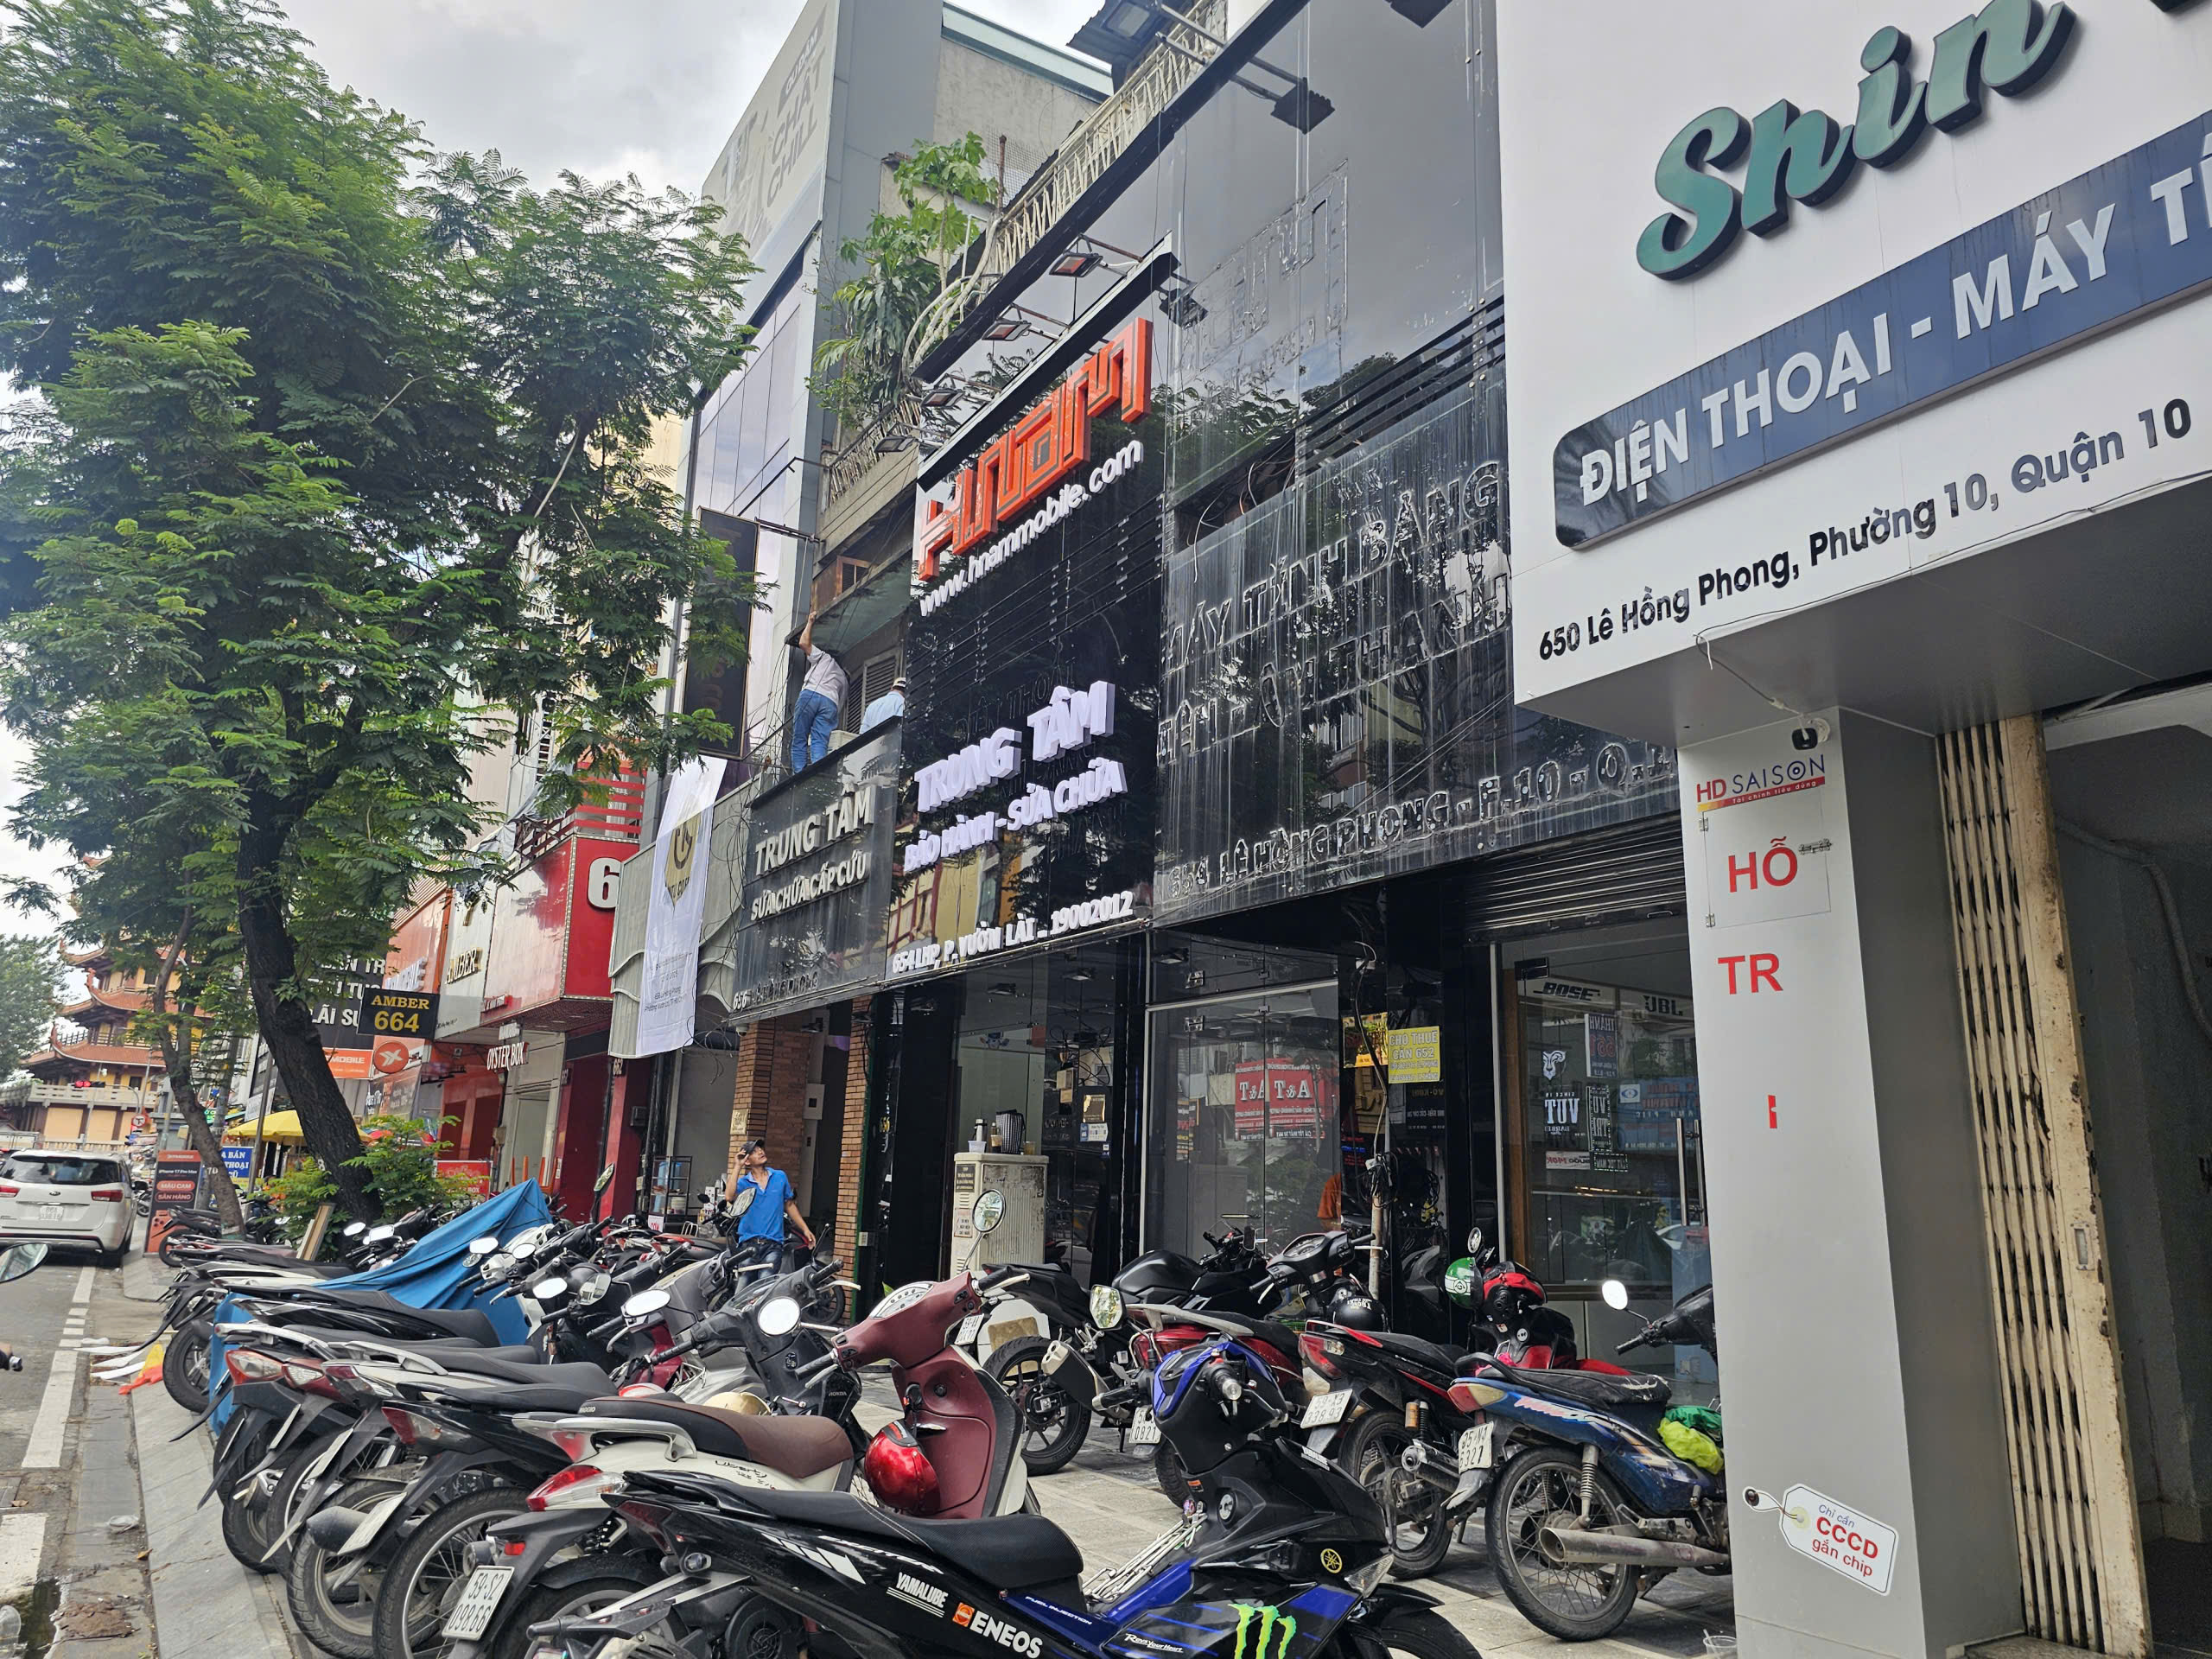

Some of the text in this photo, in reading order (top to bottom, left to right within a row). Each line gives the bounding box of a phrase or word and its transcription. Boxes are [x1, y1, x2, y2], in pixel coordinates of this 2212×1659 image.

[767, 104, 818, 207] CHILL
[1580, 410, 1688, 506] ĐIỆN
[1701, 313, 1894, 449] THOẠI
[1952, 202, 2117, 340] MÁY
[1539, 398, 2193, 661] 650 Lê Hồng Phong, Phường 10, Quận 10
[914, 680, 1116, 814] TRUNG TÂM
[1696, 754, 1826, 803] HD SAISON
[1748, 791, 1771, 802] chính
[1774, 786, 1791, 797] tiêu
[1795, 779, 1817, 791] dùng
[755, 784, 876, 876] TRUNG TÂM
[904, 830, 941, 874] BẢO
[941, 810, 1000, 858] HÀNH
[1007, 783, 1058, 831] SỬA
[1054, 756, 1128, 814] CHỮA
[1337, 790, 1450, 855] PHONG
[751, 849, 871, 921] SỬA CHỮA CẤP CỨU
[1728, 836, 1798, 893] HỖ
[958, 921, 1003, 956] VƯỜN
[1005, 912, 1037, 946] LÀI
[1050, 890, 1134, 935] 19002012
[1541, 982, 1599, 1001] BOSE
[1718, 953, 1783, 995] TR
[372, 995, 429, 1010] AMBER
[374, 1010, 420, 1033] 664
[1644, 995, 1684, 1017] JBL
[487, 1041, 528, 1071] OYSTER BOX
[1389, 1030, 1439, 1046] CHO THUÊ
[1415, 1047, 1434, 1058] 652
[1818, 1503, 1836, 1518] Chỉ
[1812, 1538, 1873, 1577] gắn chip
[1816, 1516, 1878, 1559] CCCD
[468, 1573, 505, 1600] 59-S2
[895, 1572, 949, 1608] YAMALUBE
[1025, 1595, 1093, 1625] FUEL INJECTION
[969, 1611, 1043, 1659] ENEOS
